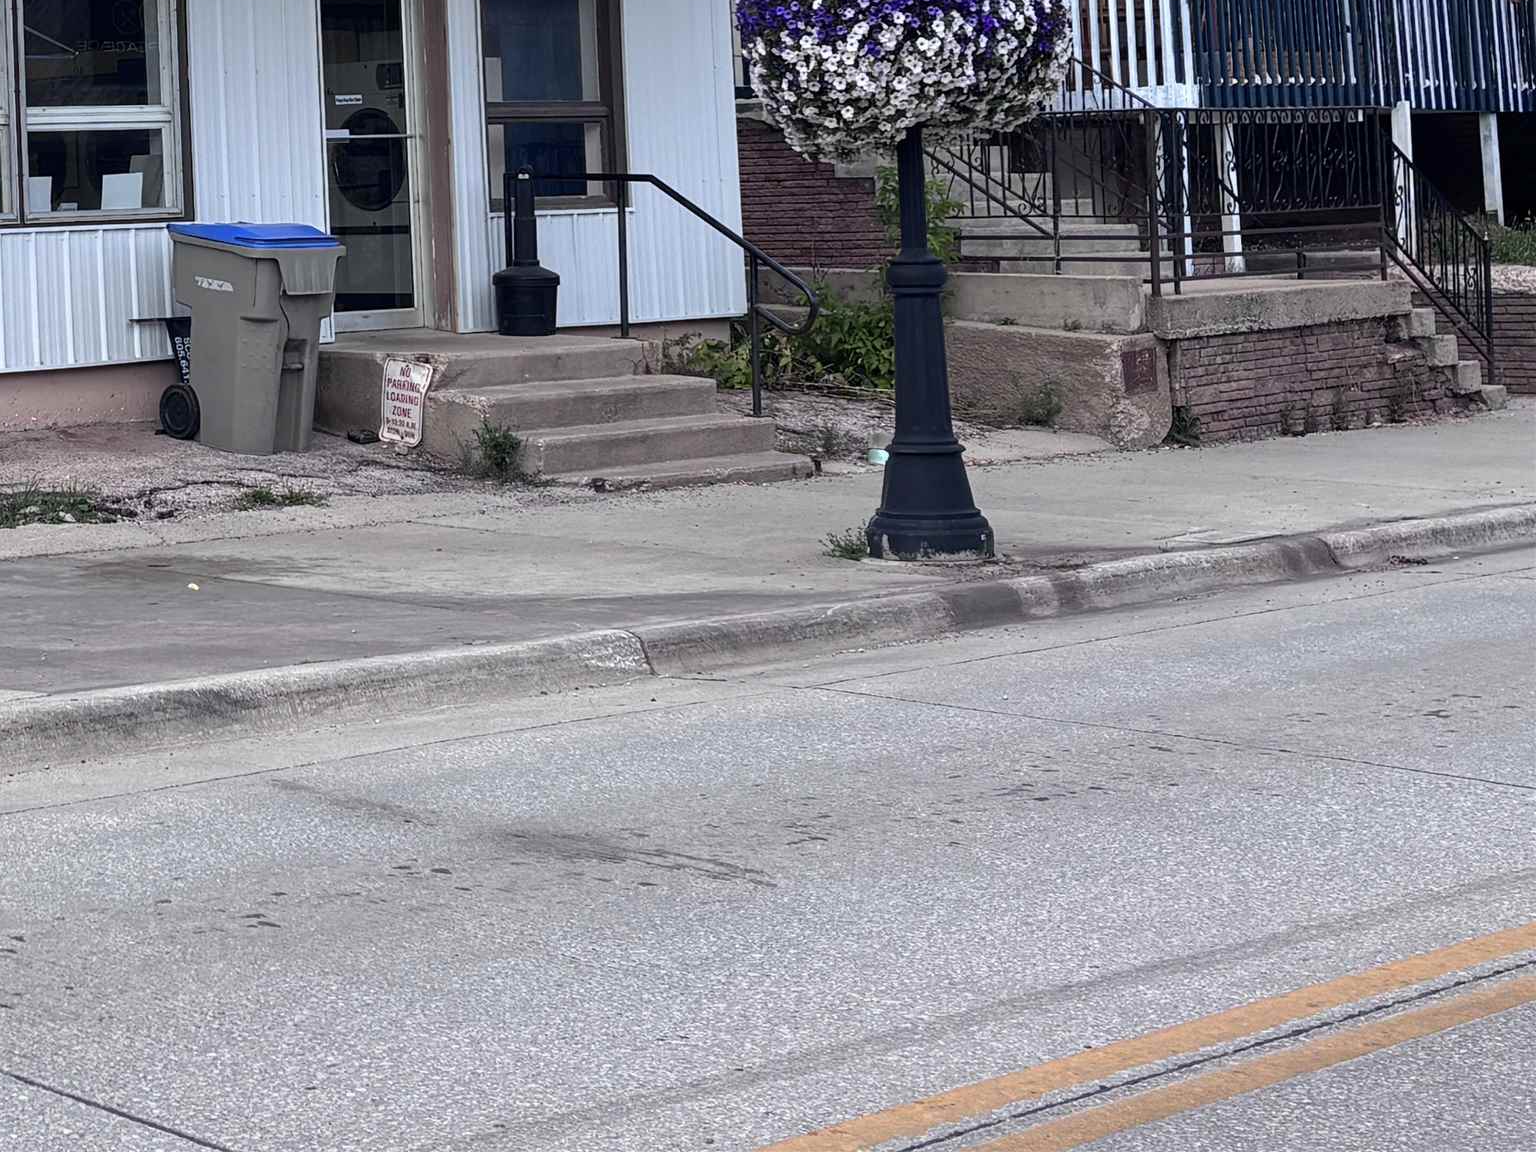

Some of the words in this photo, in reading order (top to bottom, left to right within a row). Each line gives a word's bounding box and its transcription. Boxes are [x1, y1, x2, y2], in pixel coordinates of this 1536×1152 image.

[400, 366, 412, 378] NO
[386, 377, 421, 394] PARKING
[386, 390, 419, 406] LOADING
[392, 405, 412, 419] ZONE
